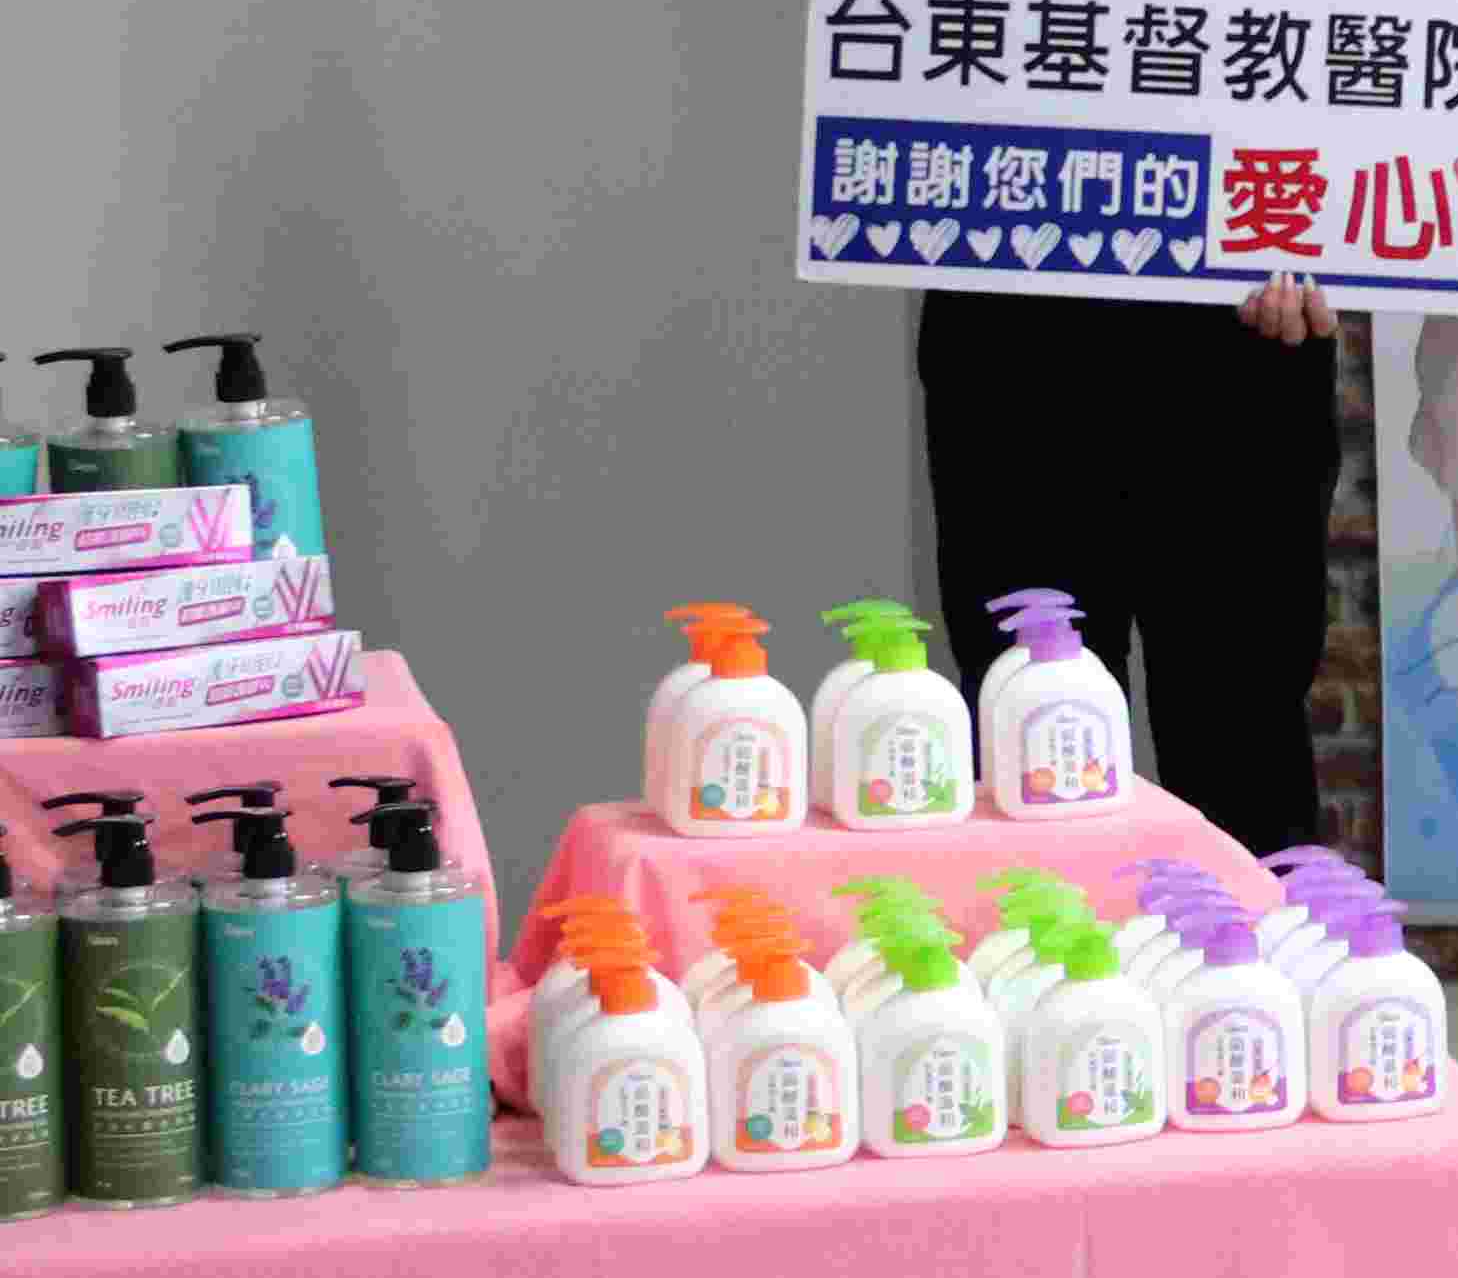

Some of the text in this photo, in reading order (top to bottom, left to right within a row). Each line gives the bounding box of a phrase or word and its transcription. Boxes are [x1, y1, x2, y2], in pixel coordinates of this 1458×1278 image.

[831, 137, 1200, 220] 謝謝您們的
[83, 592, 168, 622] Smiling
[111, 674, 194, 703] Smiling
[93, 1078, 195, 1108] TEA TREE
